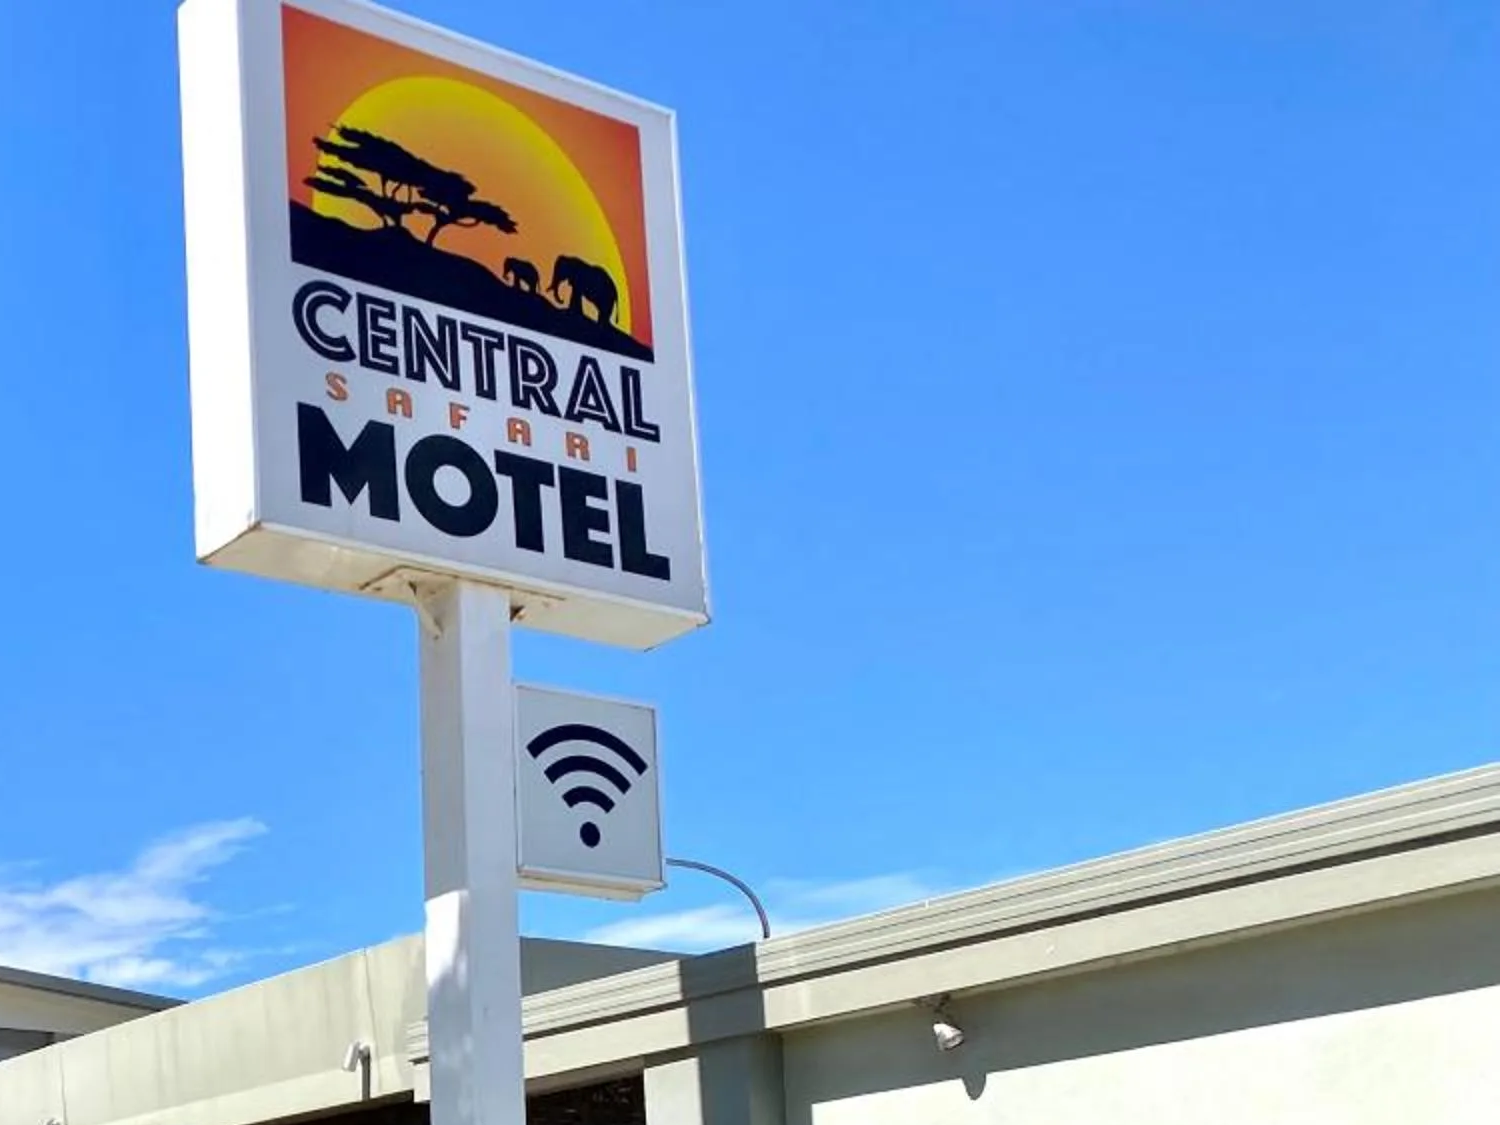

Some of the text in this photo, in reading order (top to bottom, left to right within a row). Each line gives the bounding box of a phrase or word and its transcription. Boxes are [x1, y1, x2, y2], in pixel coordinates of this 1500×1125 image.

[292, 280, 661, 443] CENTRAL
[324, 371, 638, 472] SAFARI
[296, 400, 671, 581] MOTEL
